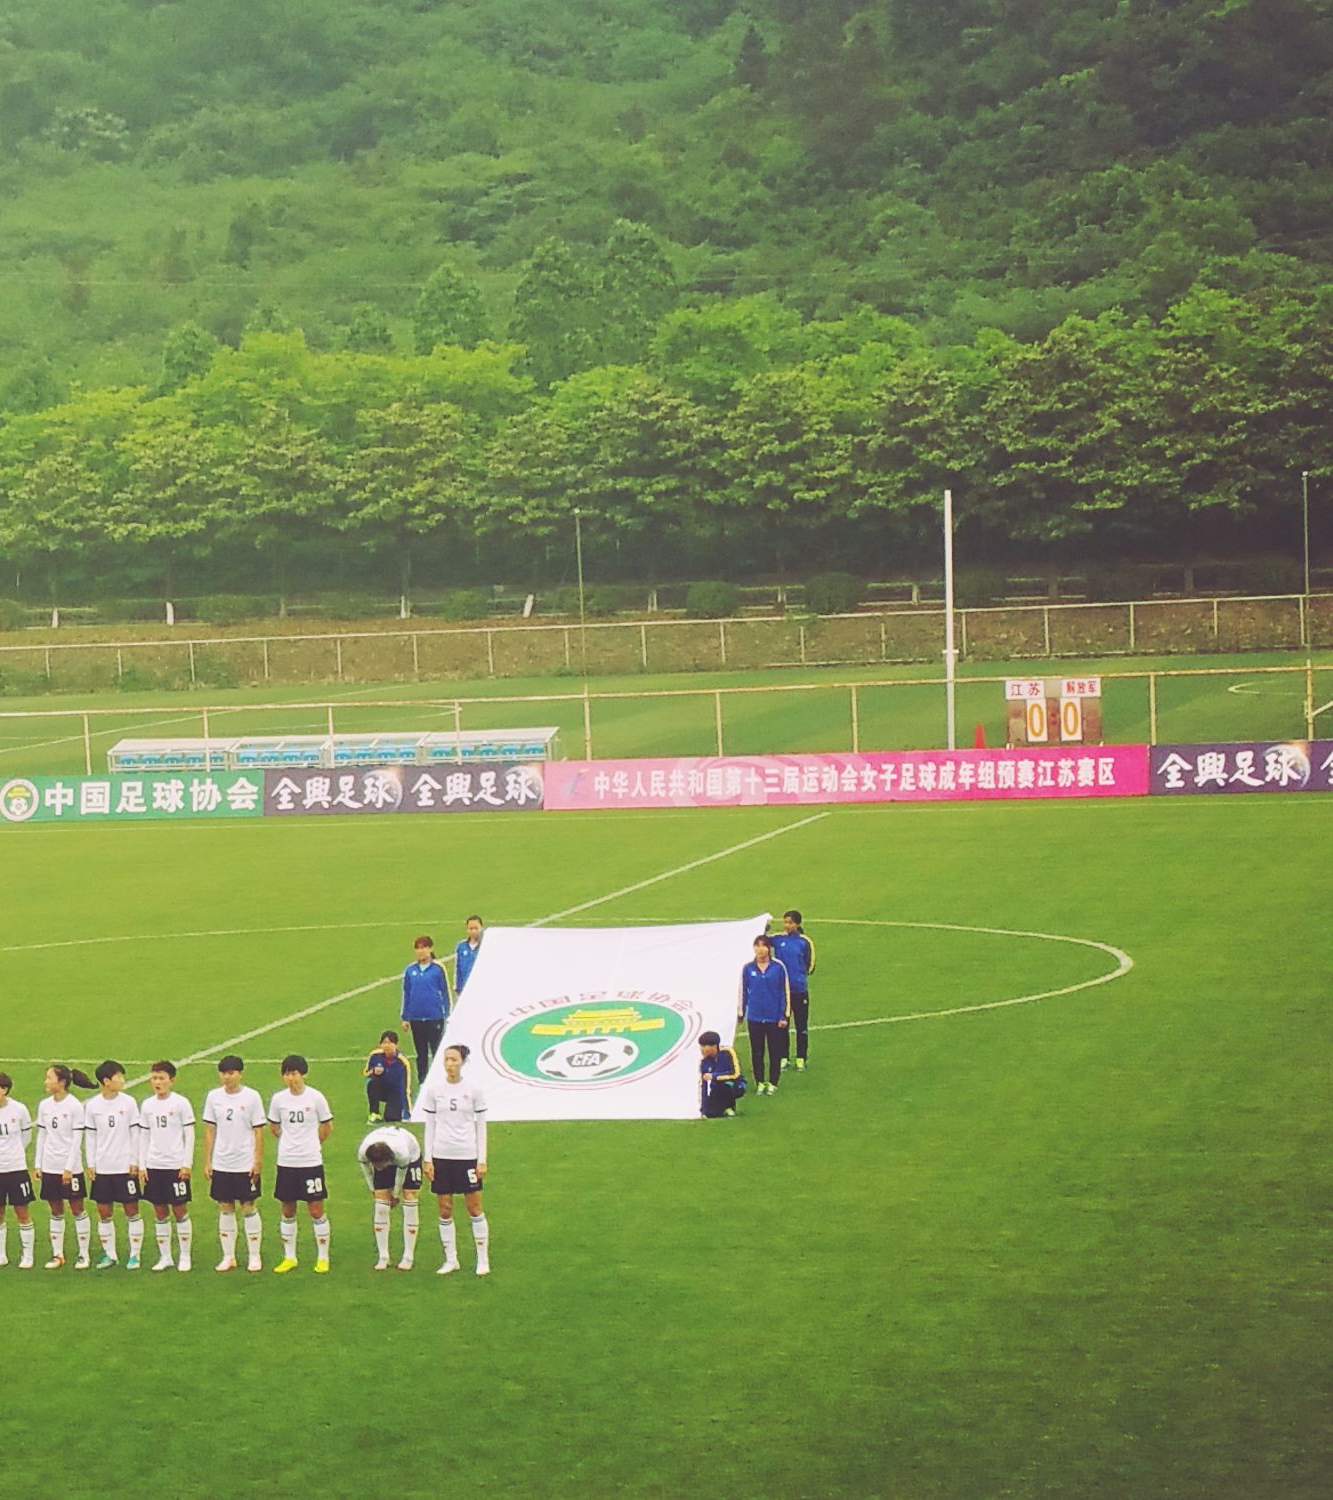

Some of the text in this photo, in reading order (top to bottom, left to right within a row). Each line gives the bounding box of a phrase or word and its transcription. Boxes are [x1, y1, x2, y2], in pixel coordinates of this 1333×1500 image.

[1010, 683, 1041, 696] 江苏
[1066, 680, 1097, 694] 解放军
[1028, 701, 1079, 737] 0 0
[1157, 751, 1301, 788] 全興足球
[594, 757, 1116, 799] 中华人民共和国第十三届运动会女子足球成年组预赛江苏赛区
[270, 775, 396, 810] 全興足球
[410, 770, 538, 807] 全興足球
[44, 777, 259, 816] 中国足球协会
[571, 1053, 601, 1067] CFA
[450, 1098, 458, 1111] 5
[108, 1115, 115, 1128] 8
[156, 1115, 168, 1128] 19
[226, 1108, 234, 1121] 2
[289, 1111, 304, 1123] 20
[51, 1116, 58, 1129] 6
[20, 1181, 31, 1197] 11
[71, 1177, 80, 1192] 6
[127, 1180, 137, 1194] 8
[173, 1182, 187, 1197] 19
[306, 1177, 323, 1194] 20
